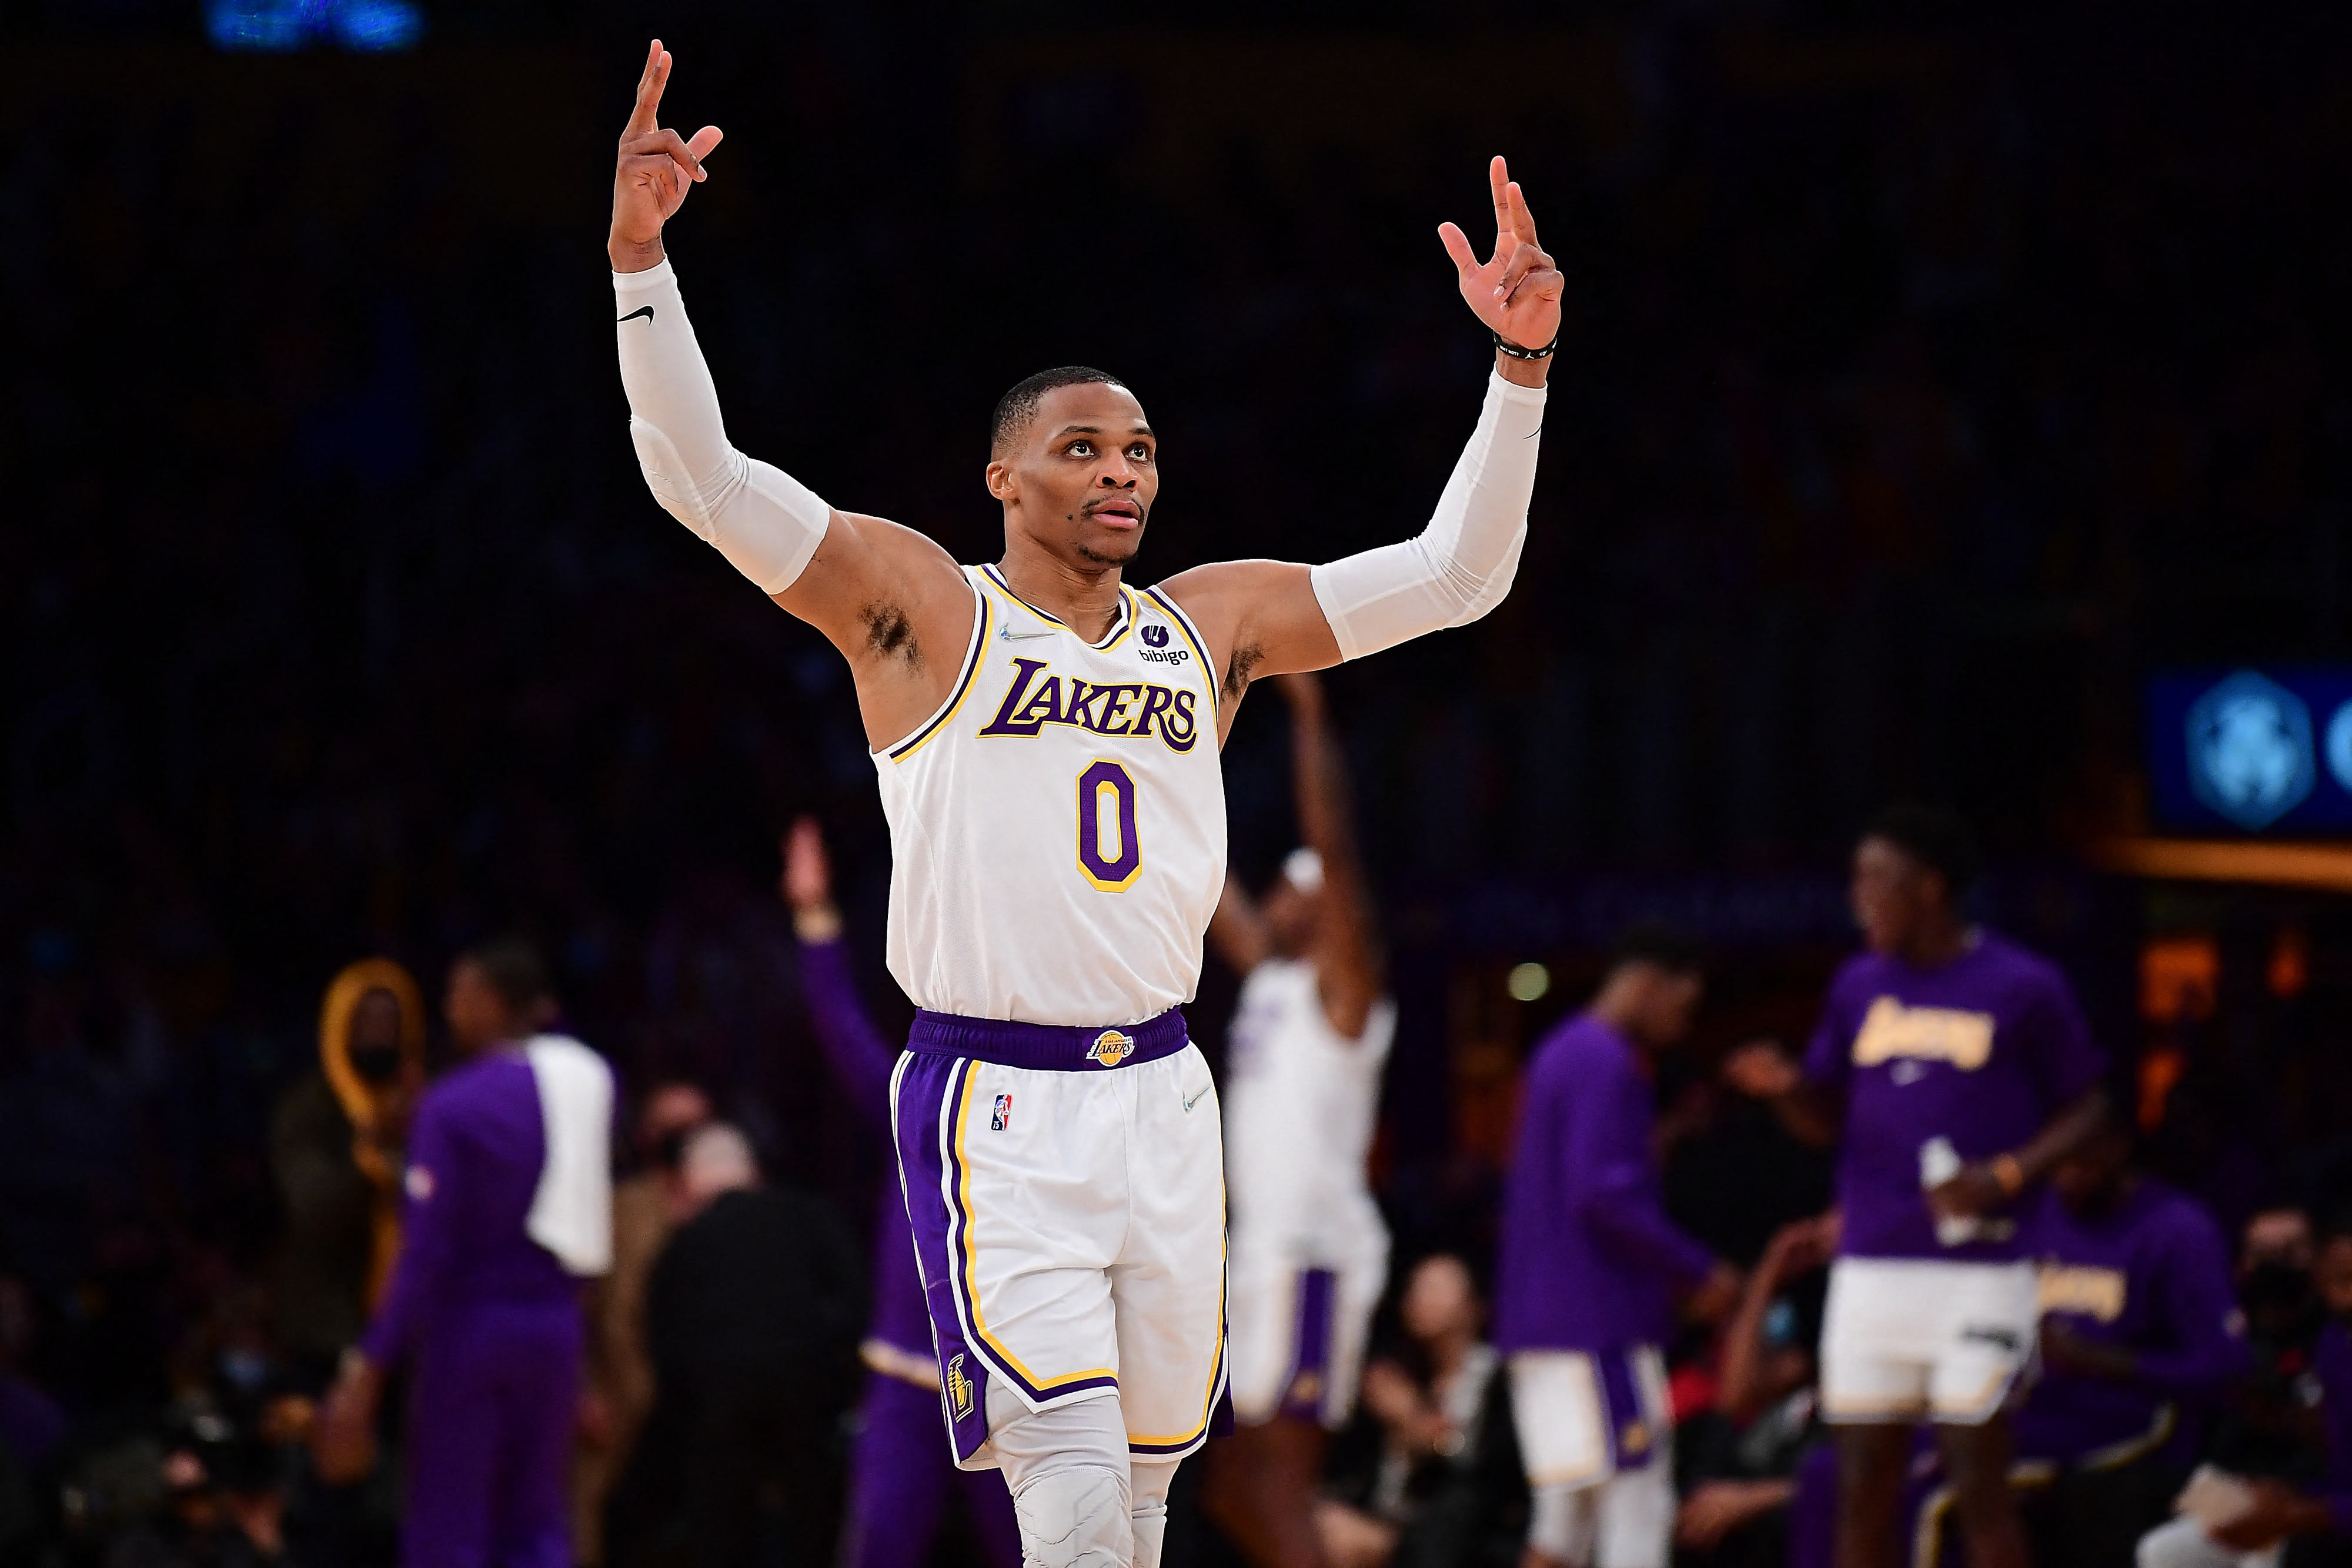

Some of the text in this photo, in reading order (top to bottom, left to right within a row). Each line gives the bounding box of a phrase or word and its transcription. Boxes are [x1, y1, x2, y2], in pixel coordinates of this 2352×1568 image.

[1138, 650, 1188, 665] bibigo
[976, 656, 1198, 755] LAKERS
[1076, 758, 1142, 893] 0
[1088, 1039, 1133, 1057] LAKERS
[993, 1121, 1000, 1129] 75
